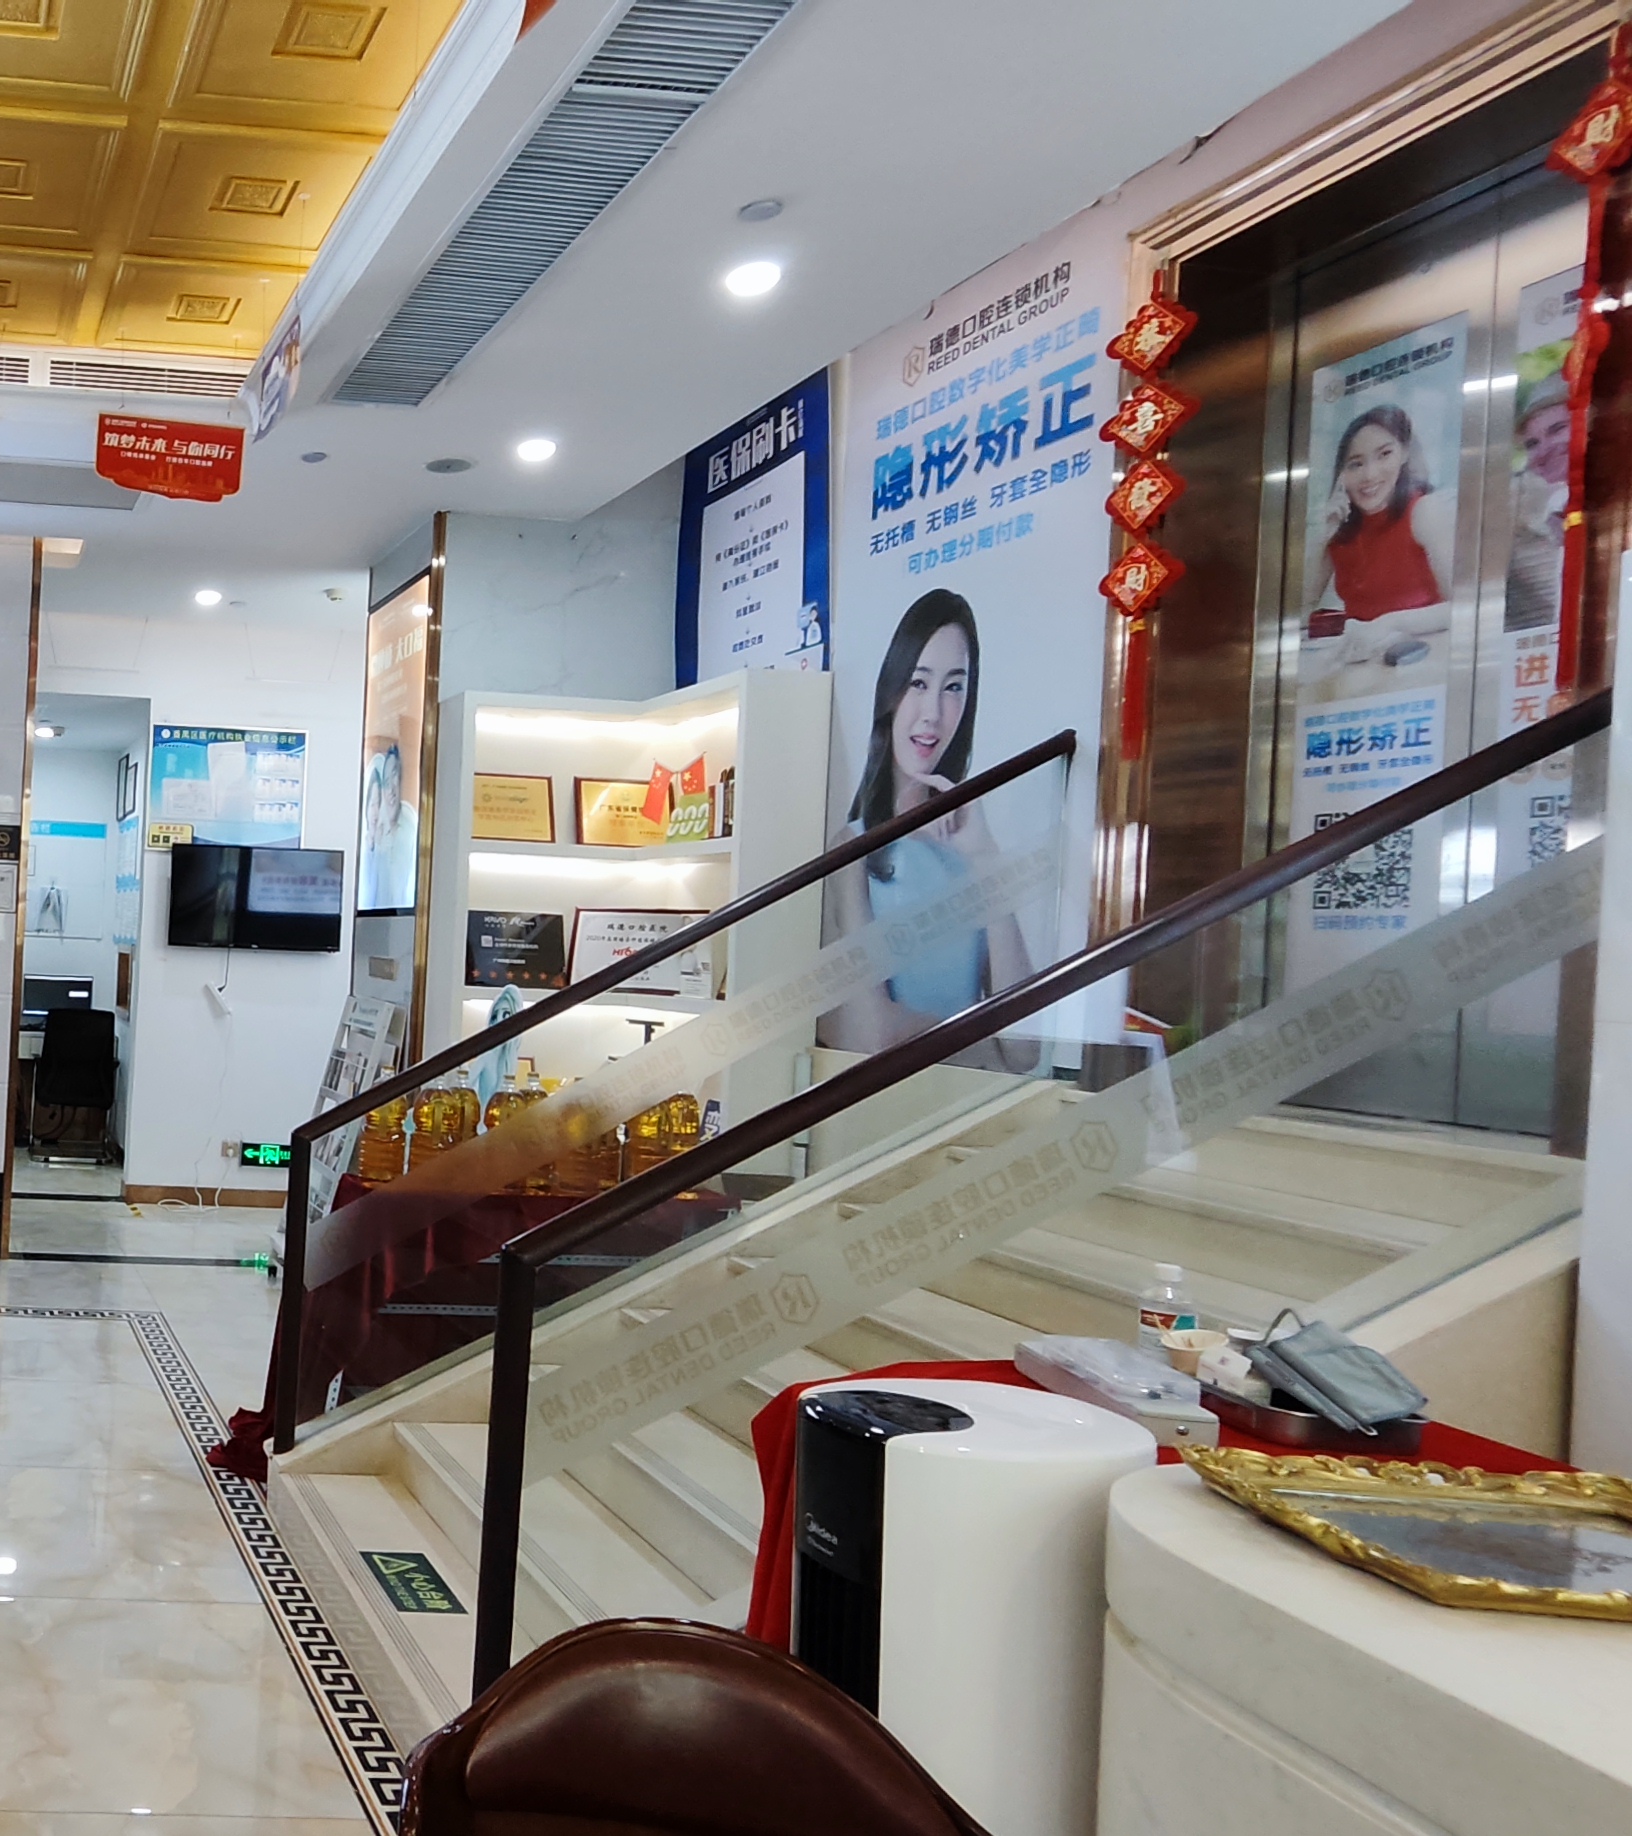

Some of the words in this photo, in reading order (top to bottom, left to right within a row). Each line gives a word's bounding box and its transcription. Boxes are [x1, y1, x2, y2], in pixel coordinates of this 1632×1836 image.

[927, 349, 960, 375] REED
[962, 321, 1015, 356] DENTAL
[1017, 287, 1071, 326] GROUP
[928, 261, 1072, 358] 瑞德口腔连锁机构
[876, 306, 1101, 441] 瑞德口腔数字化美学正畸
[172, 439, 236, 461] 与你同行
[707, 406, 798, 494] 医保刷卡
[871, 352, 1098, 521] 隐形矫正
[870, 519, 916, 556] 无托槽
[925, 495, 978, 534] 无钢丝
[989, 449, 1092, 509] 牙套全隐形
[908, 512, 1035, 575] 可办理分期付款
[1306, 716, 1434, 760] 隐形矫正
